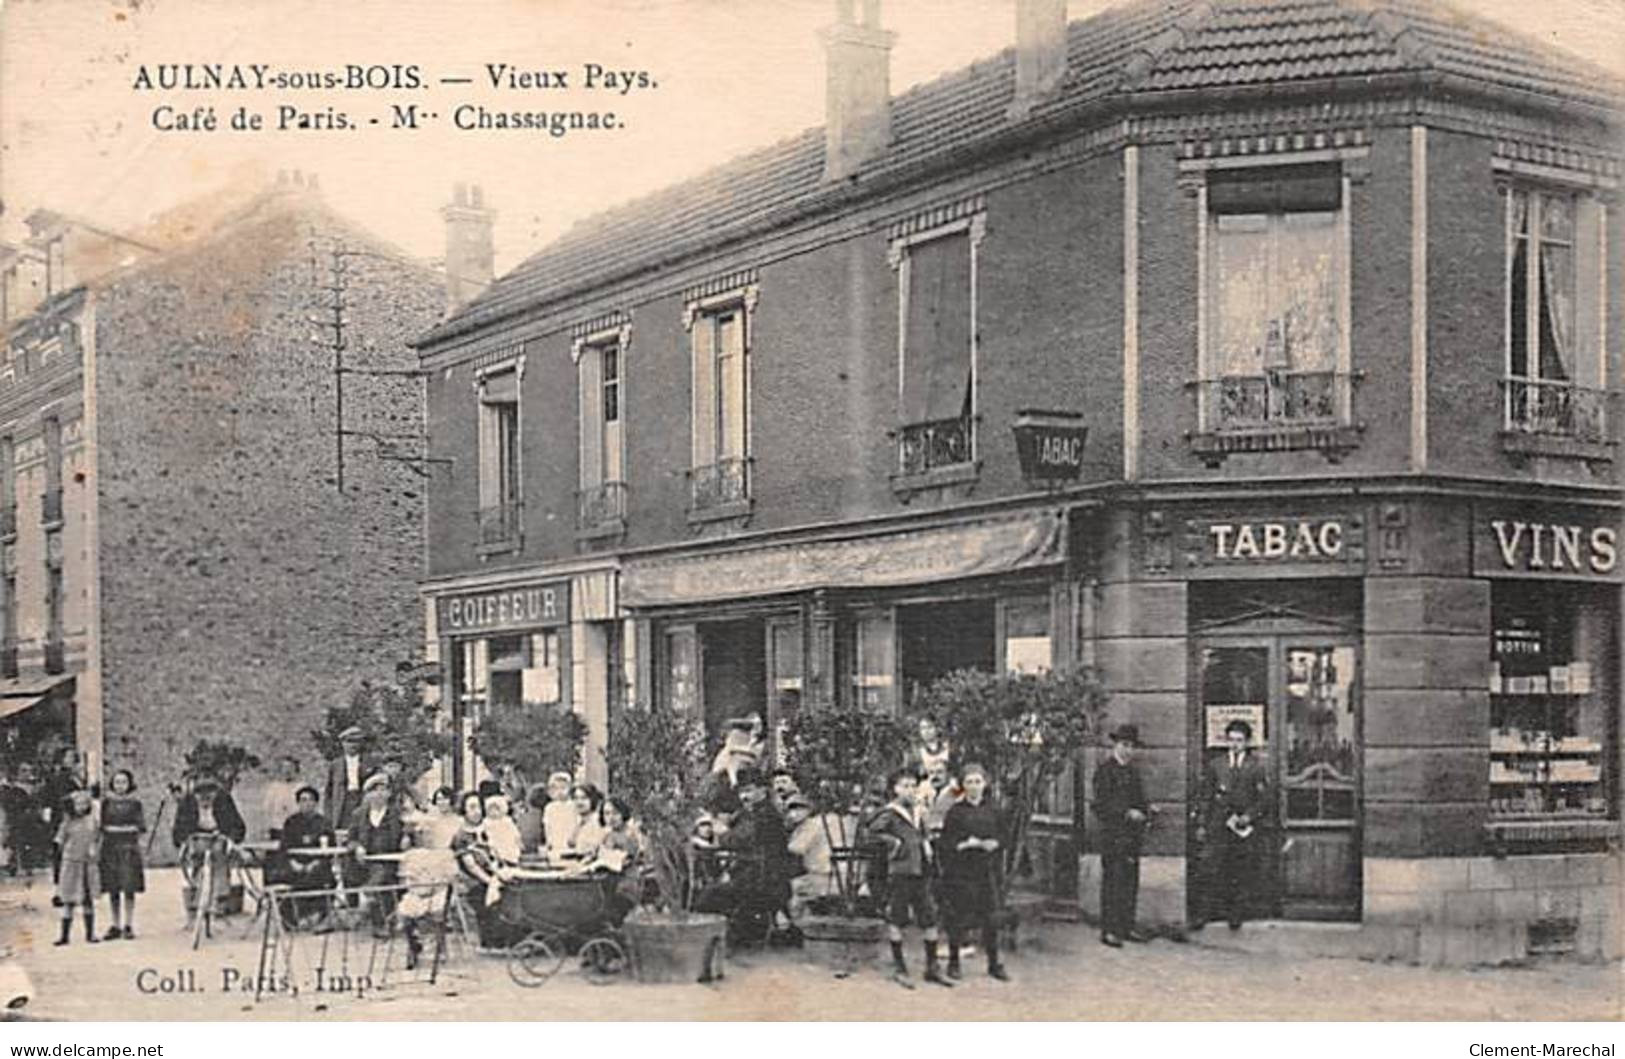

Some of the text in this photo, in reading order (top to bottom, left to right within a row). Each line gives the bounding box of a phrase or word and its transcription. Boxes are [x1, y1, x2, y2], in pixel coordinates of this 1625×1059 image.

[1210, 522, 1342, 558] TABAC
[1491, 521, 1617, 572] VINS
[450, 588, 557, 628] COIFFEUR
